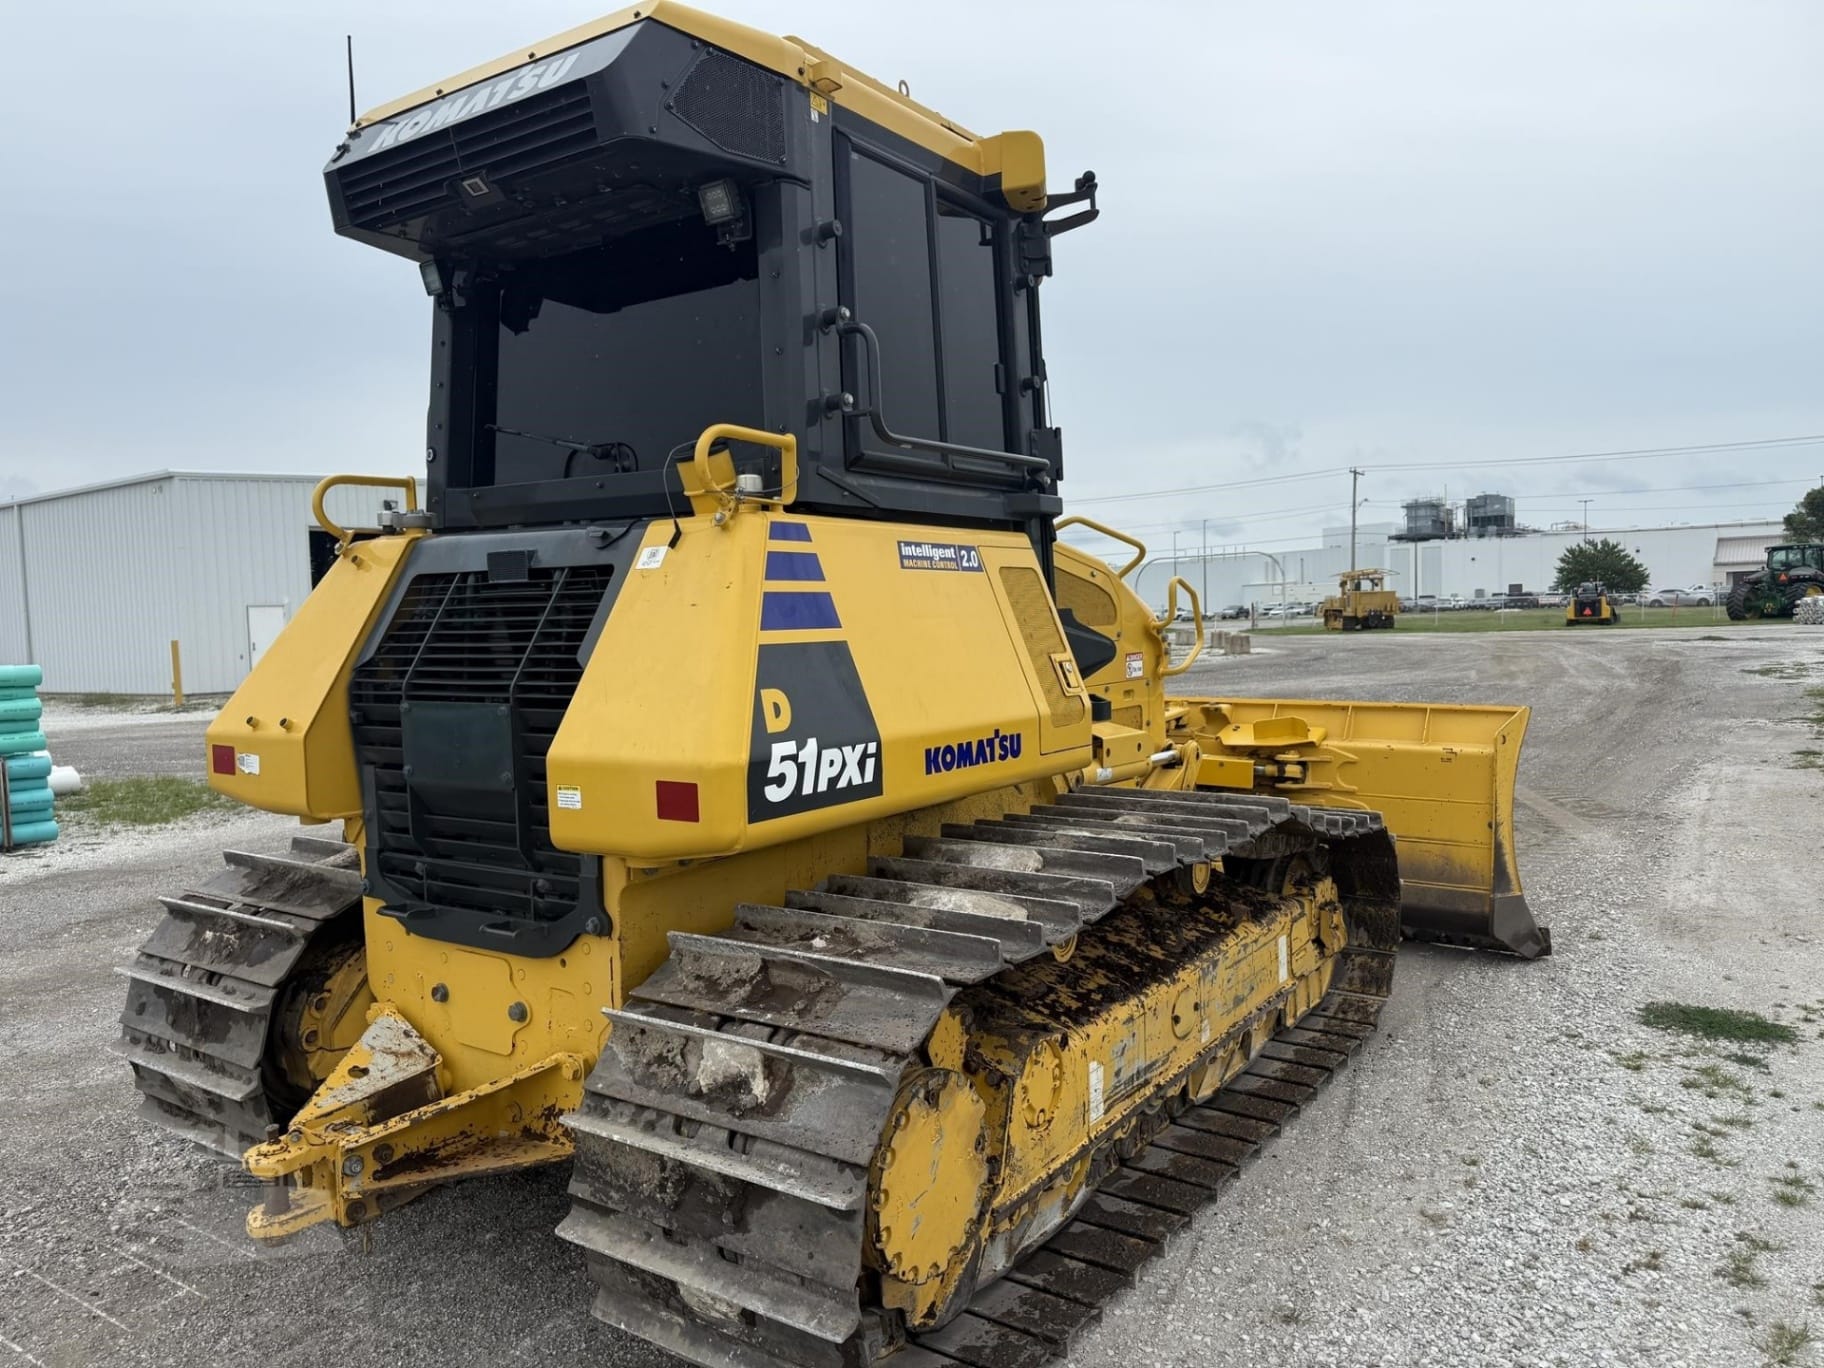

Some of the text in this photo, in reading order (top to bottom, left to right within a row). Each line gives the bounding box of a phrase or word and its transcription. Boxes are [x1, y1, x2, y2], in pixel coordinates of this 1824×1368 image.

[367, 52, 581, 153] KOMATSU
[901, 543, 956, 560] intelligent
[903, 559, 958, 570] MACHINE CONTROL
[960, 550, 979, 568] 2.0
[760, 688, 792, 734] D
[925, 729, 1021, 775] KOMATSU
